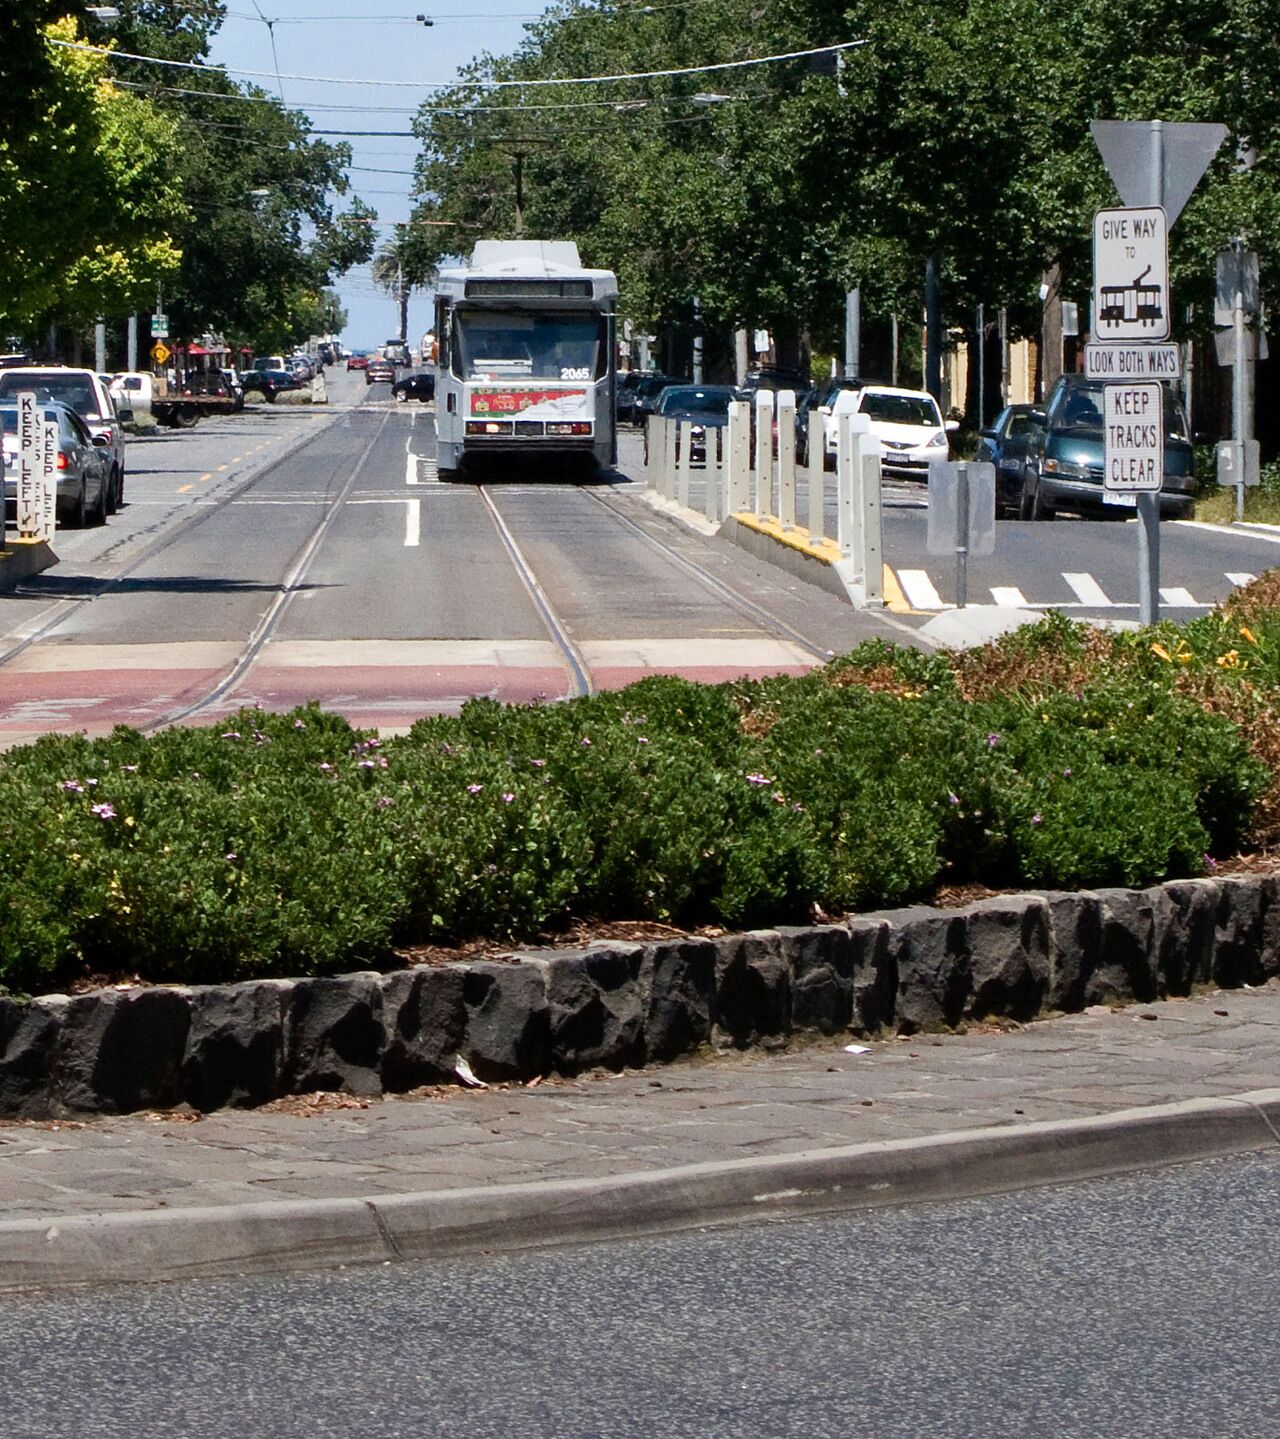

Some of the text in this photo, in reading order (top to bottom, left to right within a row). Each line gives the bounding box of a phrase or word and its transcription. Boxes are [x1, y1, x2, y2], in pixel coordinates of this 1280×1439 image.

[1102, 218, 1157, 240] GIVE WAY
[1125, 246, 1135, 258] TO
[1089, 350, 1176, 373] LOOK BOTH WAYS
[560, 367, 590, 380] 2065
[1114, 391, 1149, 415] KEEP
[1109, 425, 1157, 449] TRACKS
[22, 398, 32, 513] KEEP LEFT
[1111, 458, 1155, 482] CLEAR
